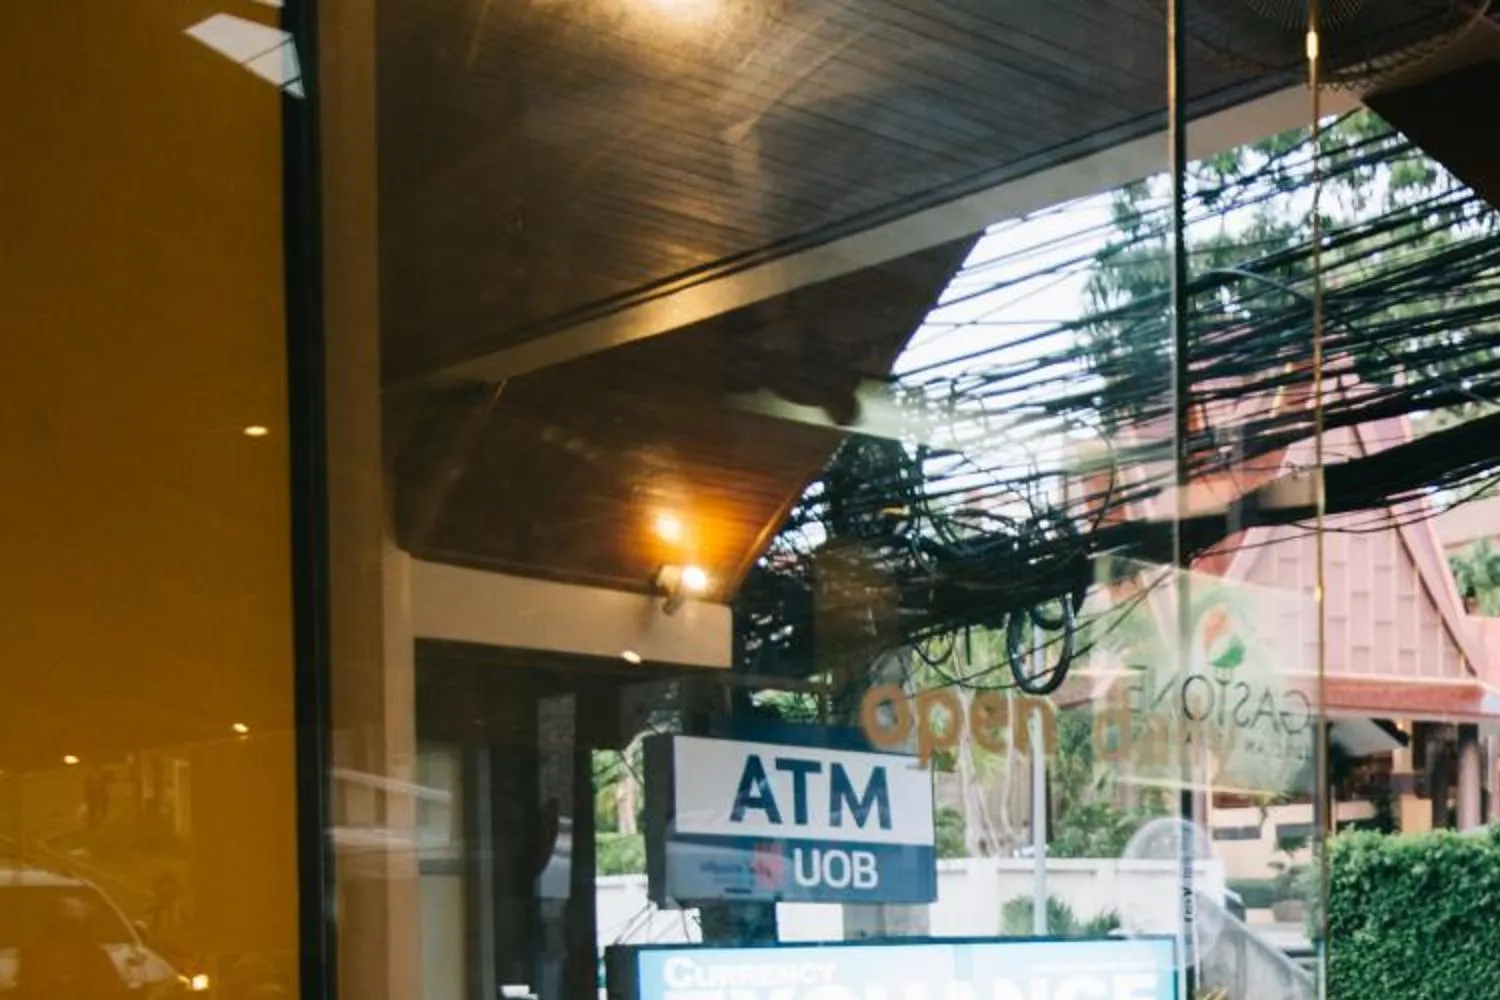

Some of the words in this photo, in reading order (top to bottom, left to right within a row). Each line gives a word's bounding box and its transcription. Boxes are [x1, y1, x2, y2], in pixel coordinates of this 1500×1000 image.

[860, 683, 1057, 768] open
[729, 753, 893, 830] ATM
[793, 848, 878, 890] UOB
